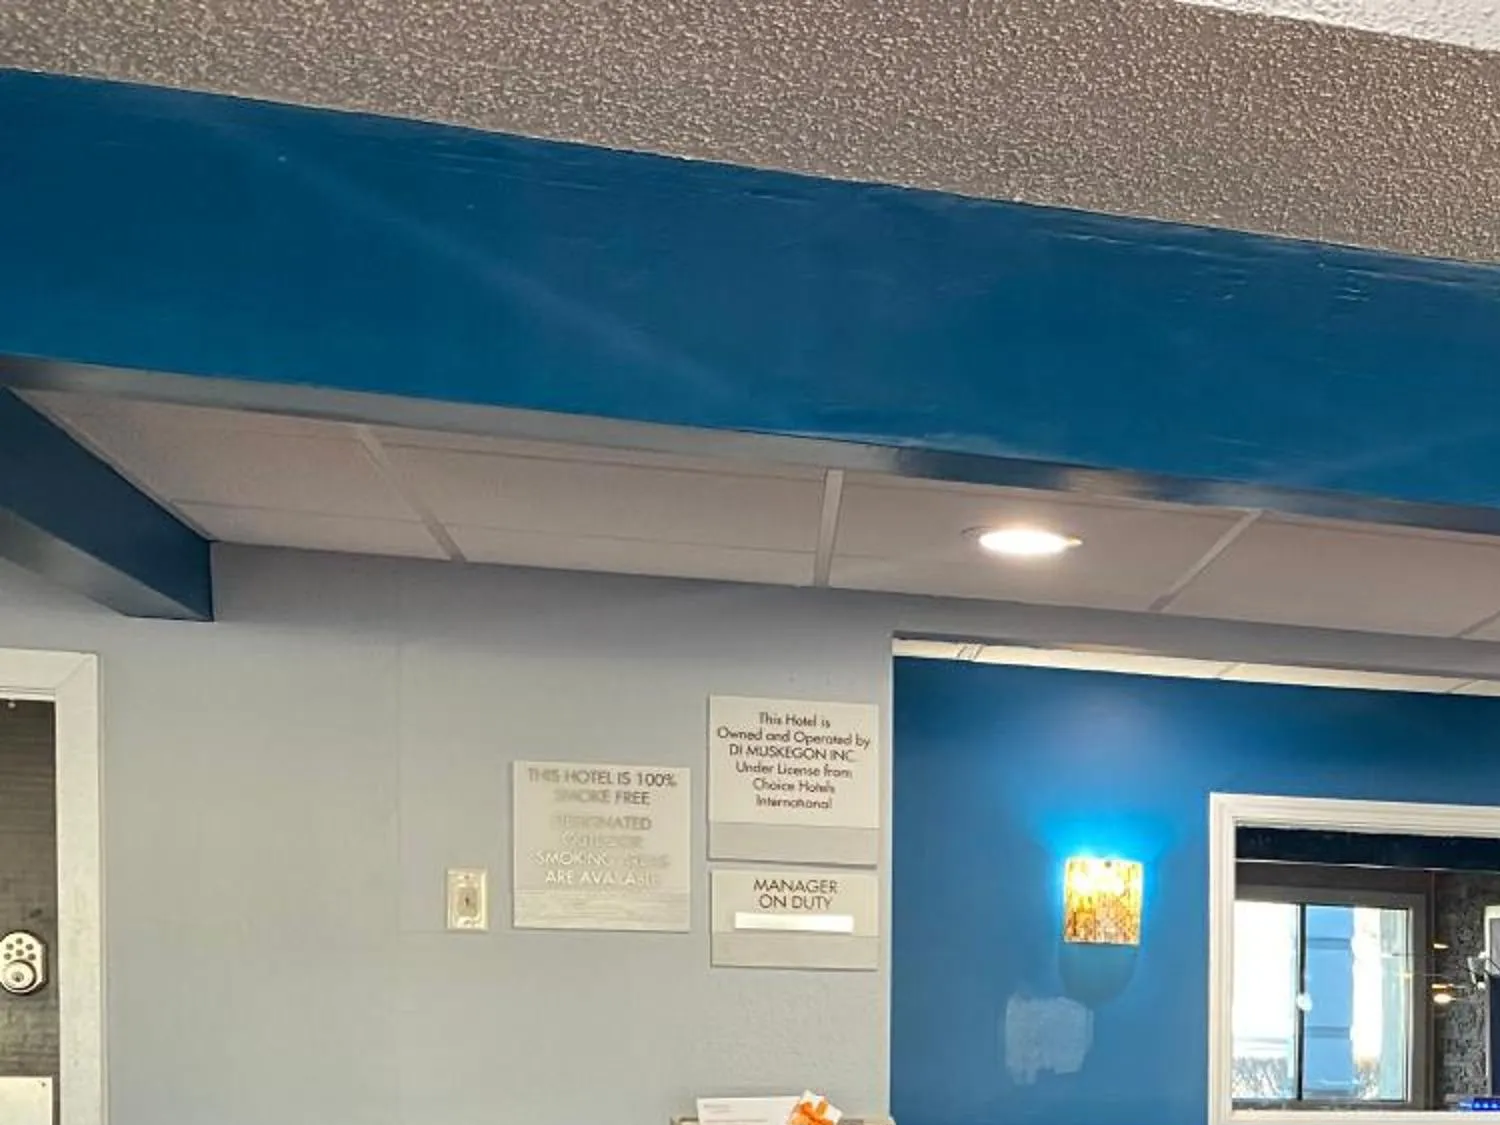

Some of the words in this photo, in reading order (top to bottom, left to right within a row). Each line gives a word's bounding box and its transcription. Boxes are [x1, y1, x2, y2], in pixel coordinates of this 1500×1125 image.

[760, 711, 782, 726] This
[786, 713, 817, 728] Hotel
[820, 716, 831, 729] is
[717, 725, 763, 742] Owned
[766, 729, 791, 743] and
[793, 731, 853, 747] Operated
[855, 733, 871, 751] by
[746, 744, 827, 761] MUSKEGON
[528, 767, 561, 784] THIS
[563, 768, 614, 786] HOTEL
[617, 771, 632, 786] IS
[636, 771, 678, 788] 100%
[735, 760, 774, 774] Under
[777, 762, 821, 777] License
[823, 763, 853, 779] from
[752, 777, 796, 791] Choice
[799, 779, 836, 794] Hotels
[552, 788, 612, 804] SMOKE
[614, 790, 652, 806] FREE
[755, 794, 833, 810] International
[545, 869, 574, 885] ARE
[579, 870, 660, 887] AVAILABLE
[753, 880, 839, 894] MANAGER
[759, 894, 789, 910] ON
[791, 896, 834, 912] DUTY
